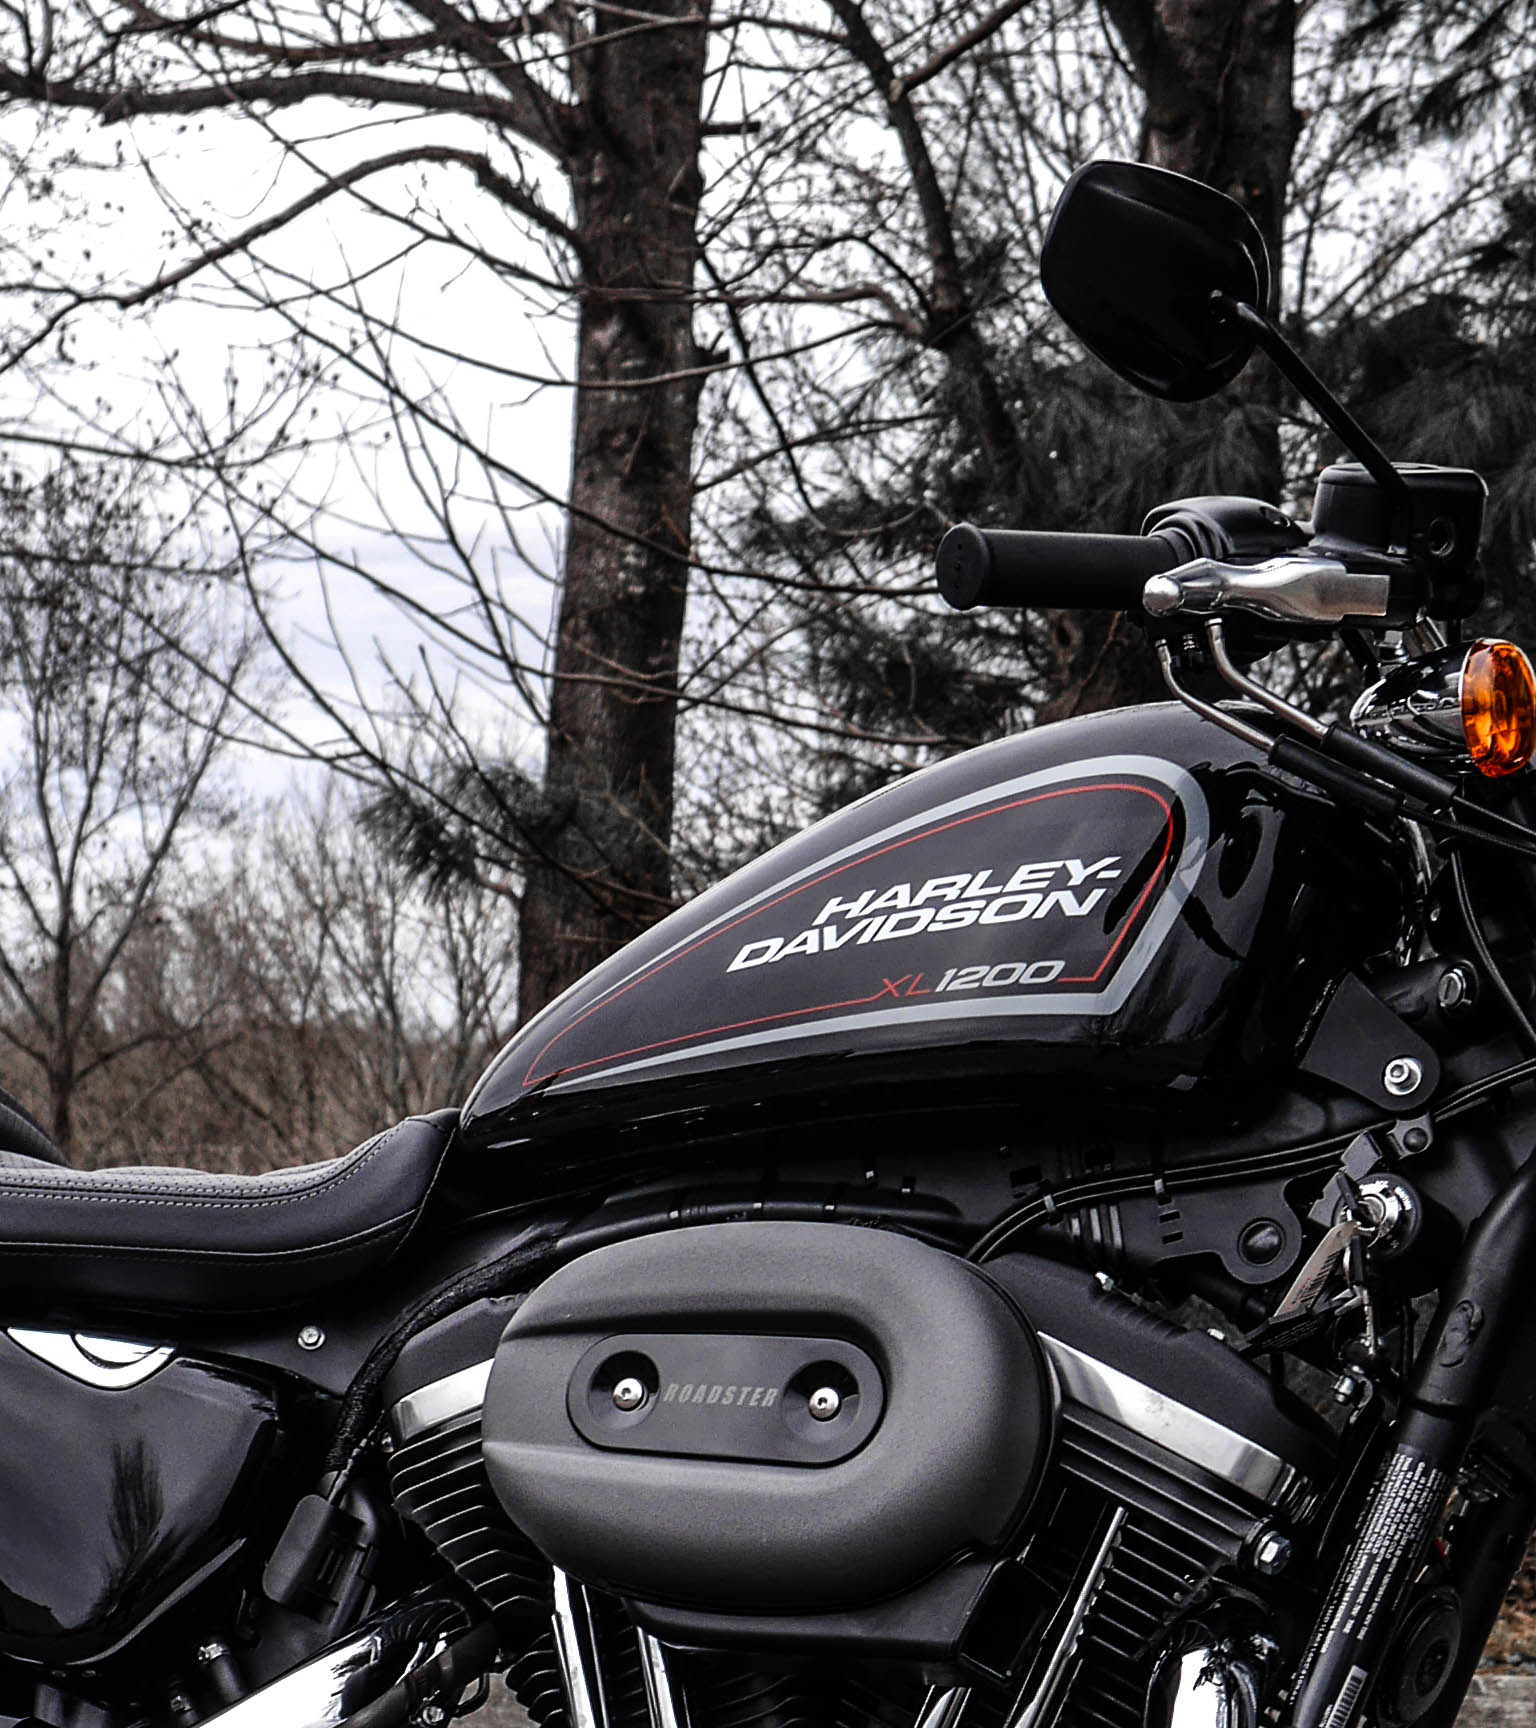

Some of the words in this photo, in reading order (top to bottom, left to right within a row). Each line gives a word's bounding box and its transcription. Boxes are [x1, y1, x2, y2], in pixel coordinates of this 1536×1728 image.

[813, 856, 1122, 926] HARLEY-
[725, 888, 1109, 973] DAVIDSON
[663, 1382, 780, 1408] ROADSTER
